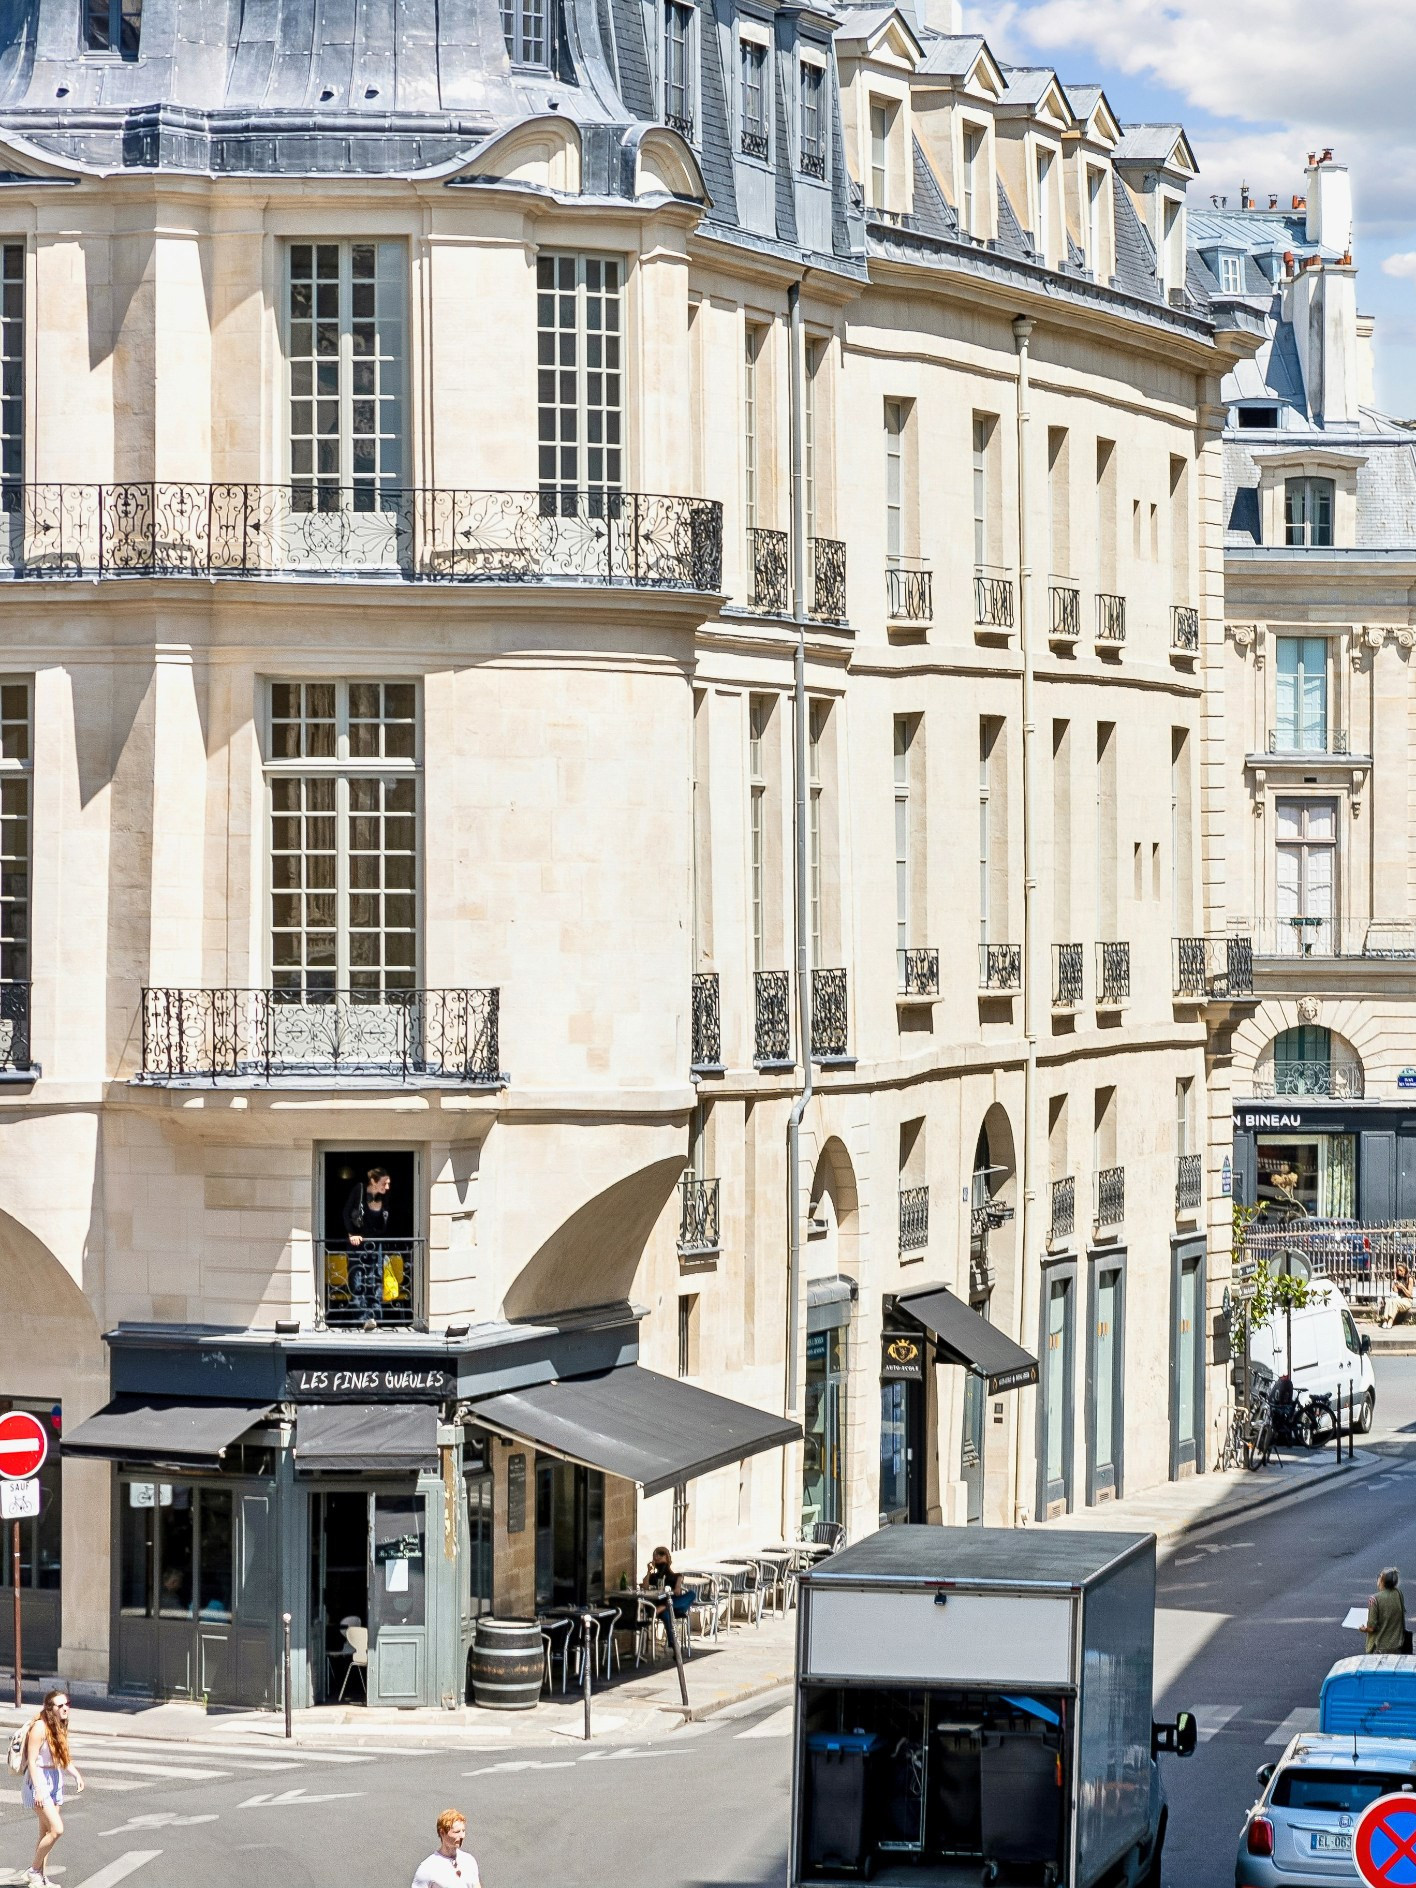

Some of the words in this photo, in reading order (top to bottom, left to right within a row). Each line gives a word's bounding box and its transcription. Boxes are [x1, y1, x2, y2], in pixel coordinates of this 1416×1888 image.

[1245, 1114, 1301, 1127] BINEAU
[300, 1371, 328, 1389] LES
[333, 1371, 379, 1391] FINES
[384, 1370, 444, 1389] GUEULES
[10, 1481, 29, 1492] SAUF
